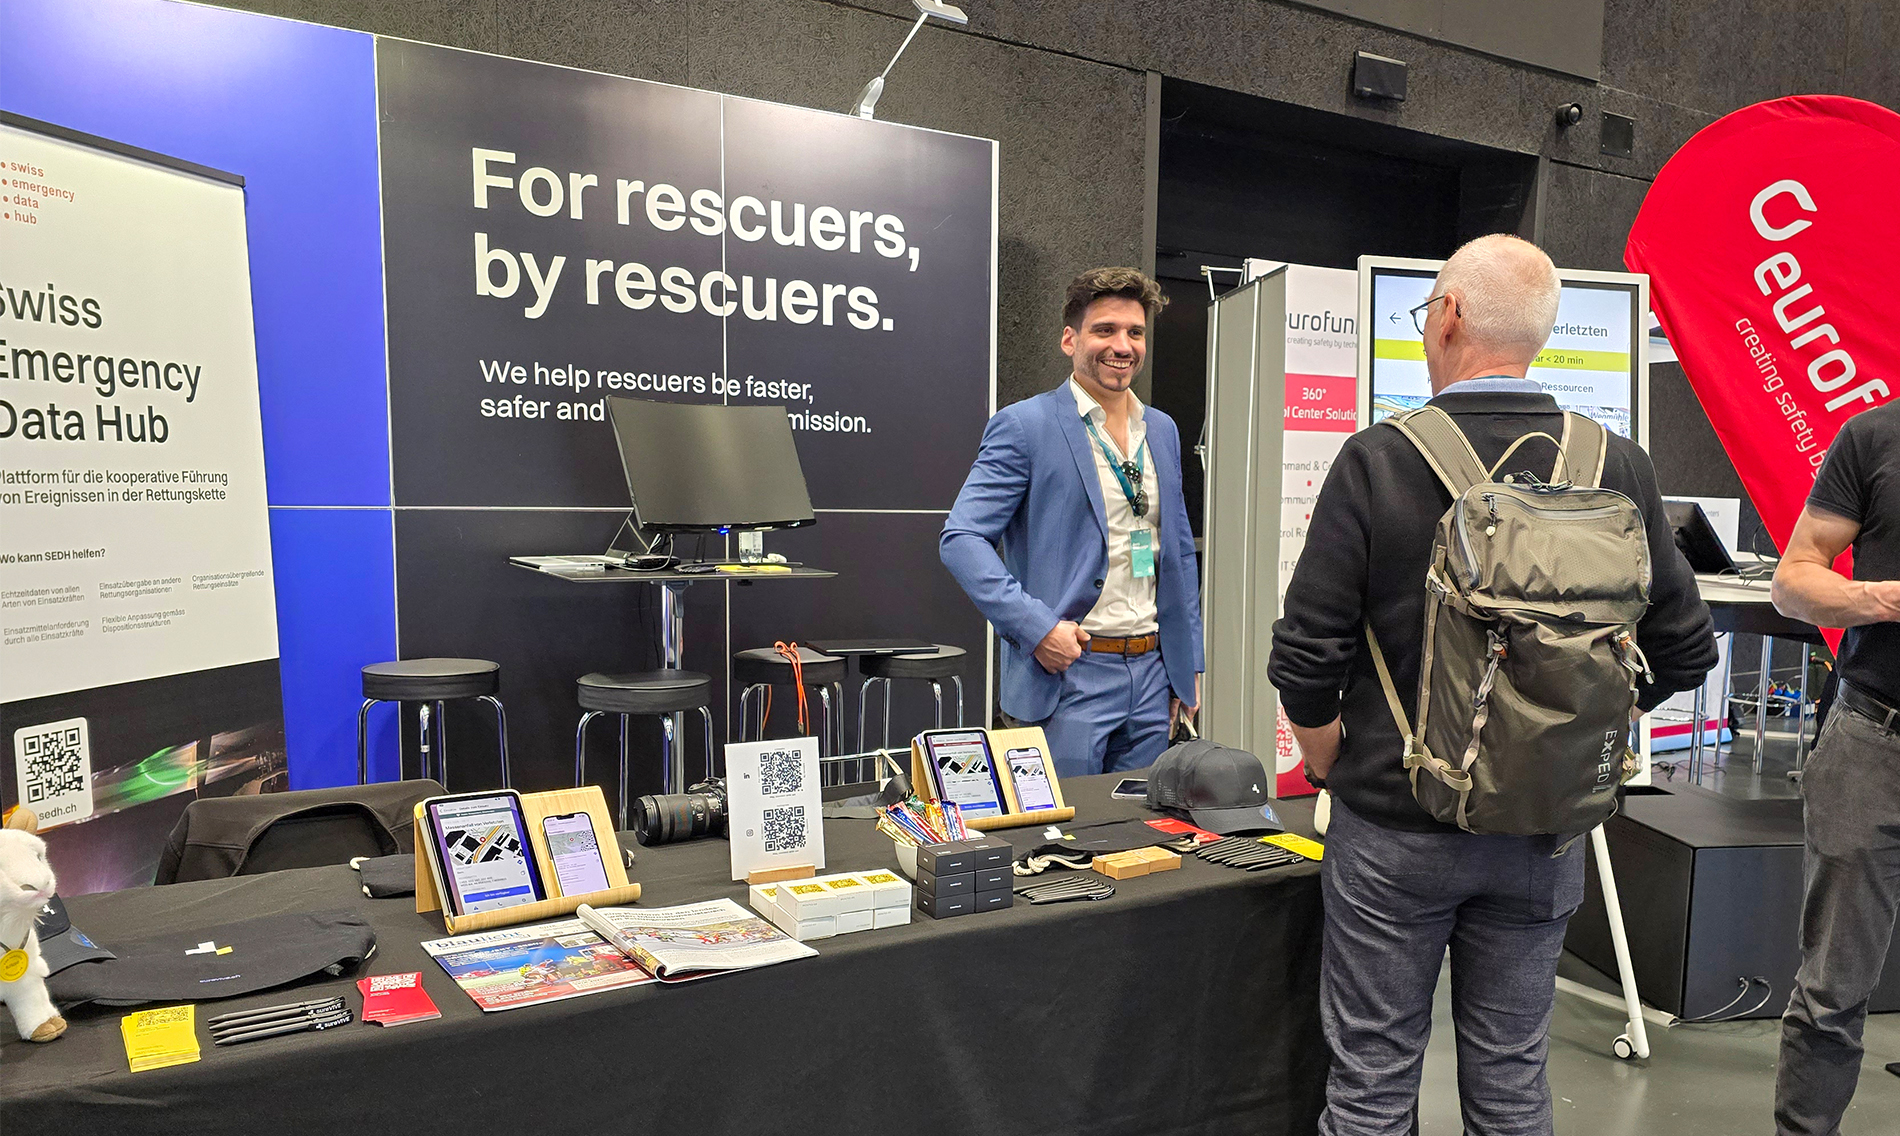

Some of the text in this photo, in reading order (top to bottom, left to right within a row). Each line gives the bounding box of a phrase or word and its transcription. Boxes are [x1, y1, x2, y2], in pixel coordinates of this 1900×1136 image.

[11, 162, 44, 177] swiss
[12, 179, 74, 202] emergency
[14, 194, 38, 208] data
[14, 210, 36, 224] hub
[472, 148, 920, 272] For rescuers,
[474, 232, 894, 331] by rescuers.
[1285, 310, 1357, 334] urofun
[1754, 252, 1890, 412] eurof
[1287, 337, 1312, 347] creating
[1314, 338, 1332, 348] safety
[1334, 340, 1342, 350] by
[1554, 355, 1564, 364] 20
[1567, 356, 1584, 364] min
[480, 360, 814, 404] We help rescuers be faster,
[1542, 382, 1594, 392] Ressourcen
[1735, 317, 1784, 393] creating
[1775, 392, 1818, 452] safety
[1302, 388, 1326, 400] 360°
[480, 396, 872, 434] safer and mission.
[1292, 406, 1324, 420] Center
[96, 404, 168, 443] Hub
[1313, 461, 1320, 471] &
[0, 470, 228, 486] lattform für die kooperative Führung
[24, 490, 104, 507] Ereignissen
[108, 489, 119, 502] in
[122, 488, 144, 502] der
[146, 488, 226, 504] Rettungskette
[0, 548, 106, 564] Wo kann SEDH helfen?
[1280, 562, 1288, 570] IT
[99, 579, 152, 590] Einsatzübergabe
[161, 576, 182, 584] andere
[192, 570, 264, 582] Organisationsübergreifende
[1, 588, 50, 600] Echtzeitdaten
[64, 586, 80, 594] allen
[100, 586, 172, 599] Rettungsorganisationen
[192, 580, 239, 590] Rettungseinsätze
[2, 600, 22, 608] Arten
[38, 594, 85, 605] Einsatzkräften
[102, 608, 186, 624] Flexible Anpassung gemäss
[4, 620, 90, 636] Einsatzmittelanforderung
[102, 619, 171, 633] Dispositionsstrukturen
[4, 629, 84, 646] durch alle Einsatzkräfte
[1596, 730, 1618, 783] EXPED
[38, 802, 77, 822] sedh.ch
[436, 931, 523, 948] blaulicht
